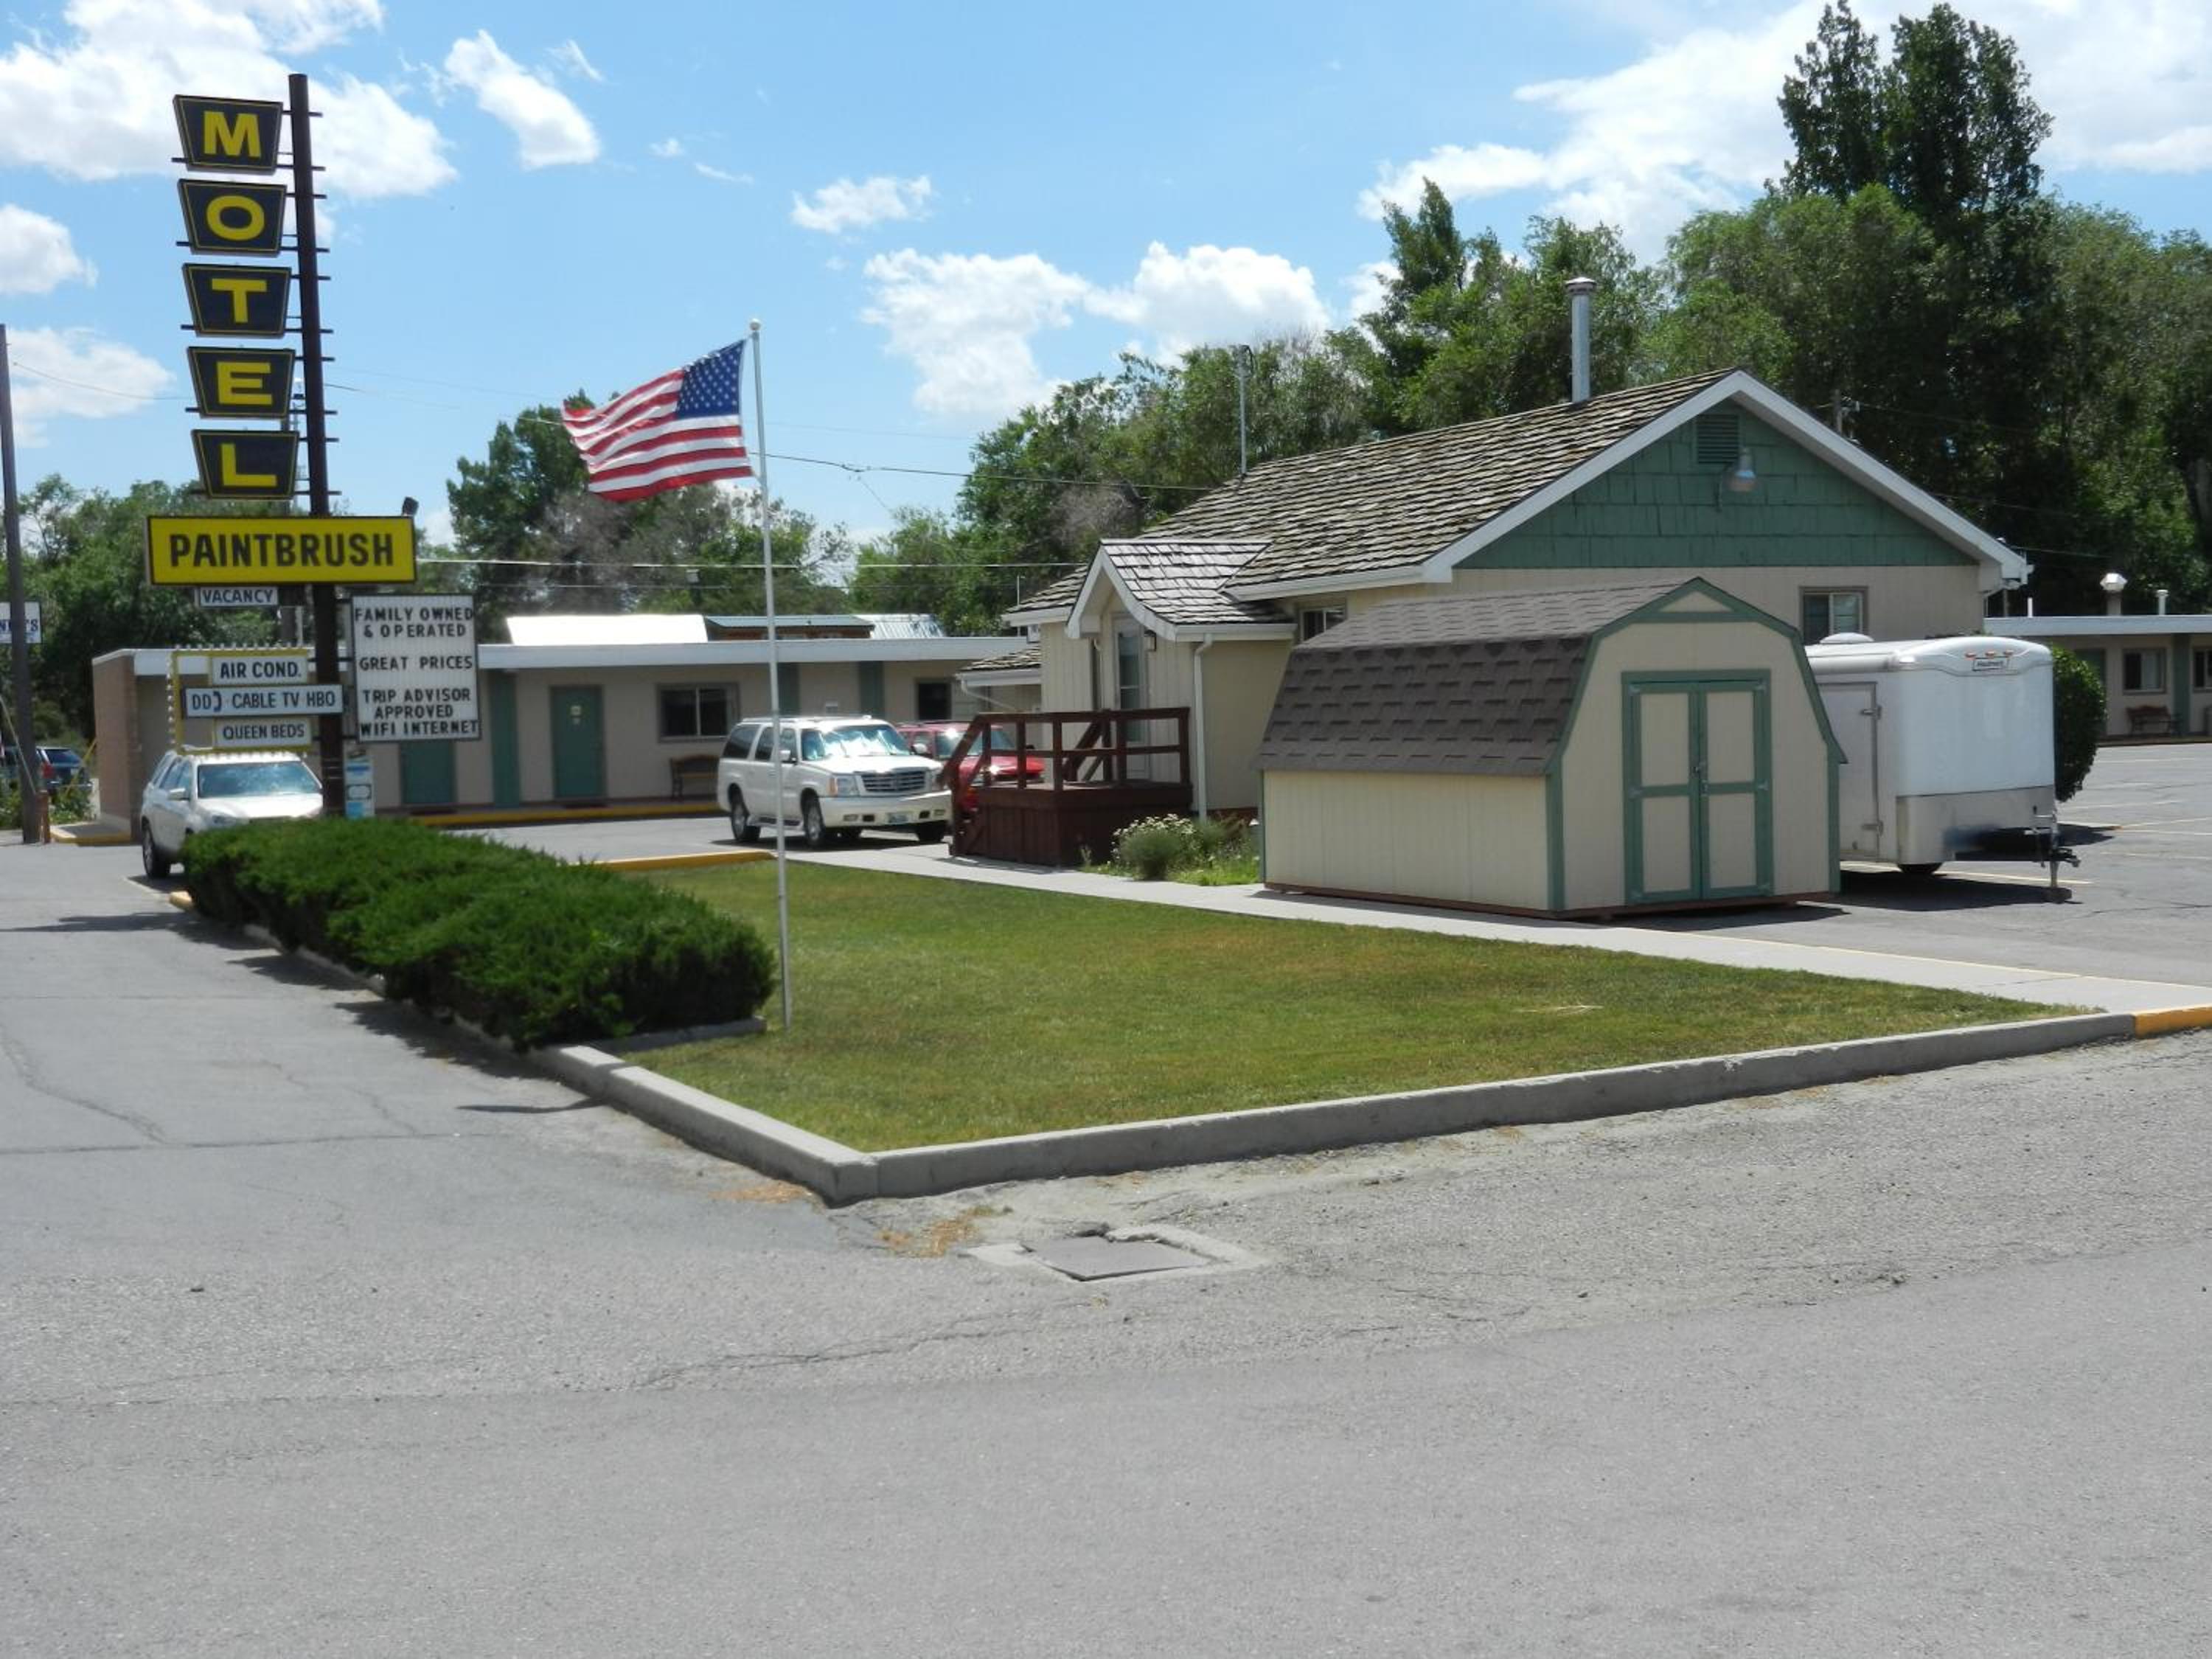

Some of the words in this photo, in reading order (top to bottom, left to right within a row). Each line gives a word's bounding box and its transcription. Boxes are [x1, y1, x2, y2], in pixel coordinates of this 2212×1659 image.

[203, 111, 277, 487] MOTEL
[170, 533, 393, 567] PAINTBRUSH
[203, 590, 274, 603] VACANCY
[355, 608, 413, 621] FAMILY
[420, 608, 473, 621] OWNED
[364, 625, 373, 638] &
[380, 624, 466, 637] OPERATED
[220, 662, 246, 678] AIR
[252, 662, 302, 678] COND.
[359, 656, 408, 671] GREAT
[420, 655, 473, 669] PRICES
[232, 692, 276, 709] CABLE
[282, 692, 299, 707] TV
[306, 690, 335, 706] HBO
[363, 689, 396, 703] TRIP
[404, 688, 470, 701] ADVISOR
[375, 705, 453, 719] APPROVED
[223, 725, 267, 740] QUEEN
[271, 724, 305, 738] BEDS
[361, 722, 396, 736] WIFI
[403, 720, 479, 736] INTERNET
